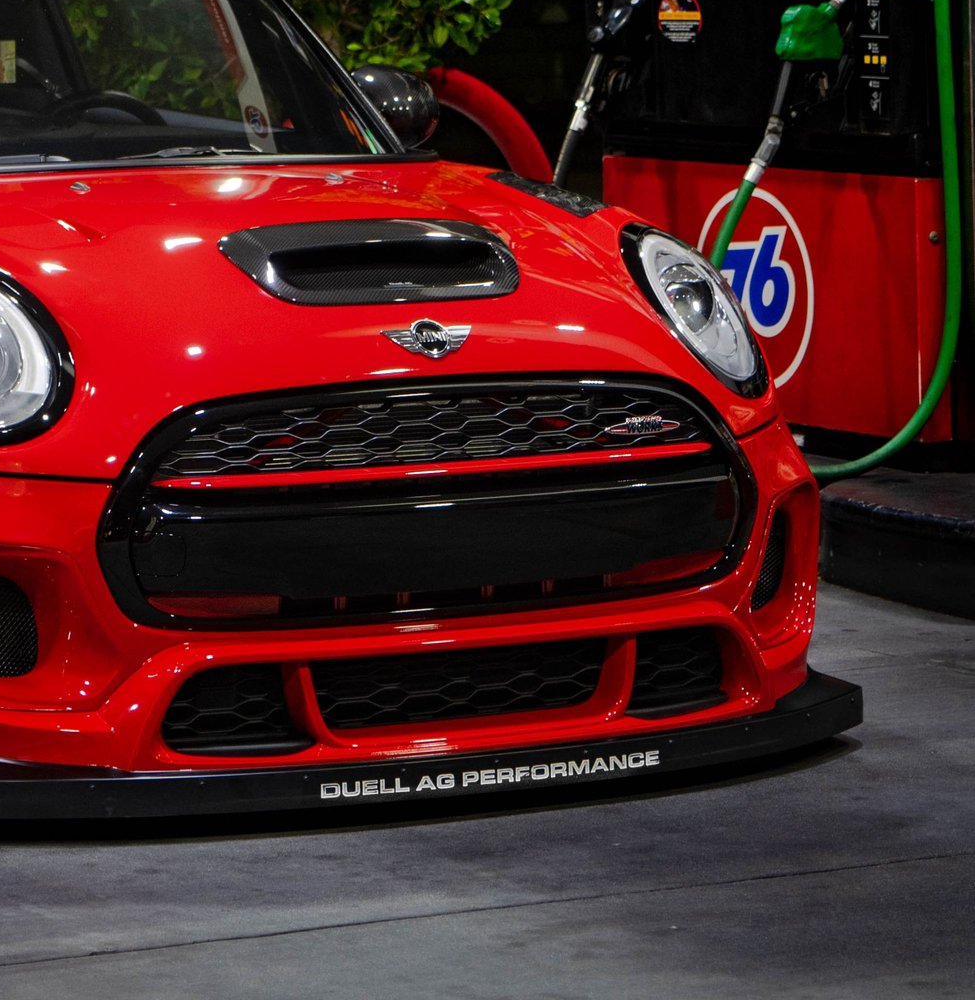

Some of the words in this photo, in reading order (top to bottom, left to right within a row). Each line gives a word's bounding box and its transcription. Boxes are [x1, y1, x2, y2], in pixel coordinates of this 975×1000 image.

[721, 227, 795, 337] 76
[415, 331, 449, 343] MINI
[320, 777, 410, 799] DUELL
[416, 772, 455, 792] AG
[462, 750, 660, 787] PERFORMANCE
